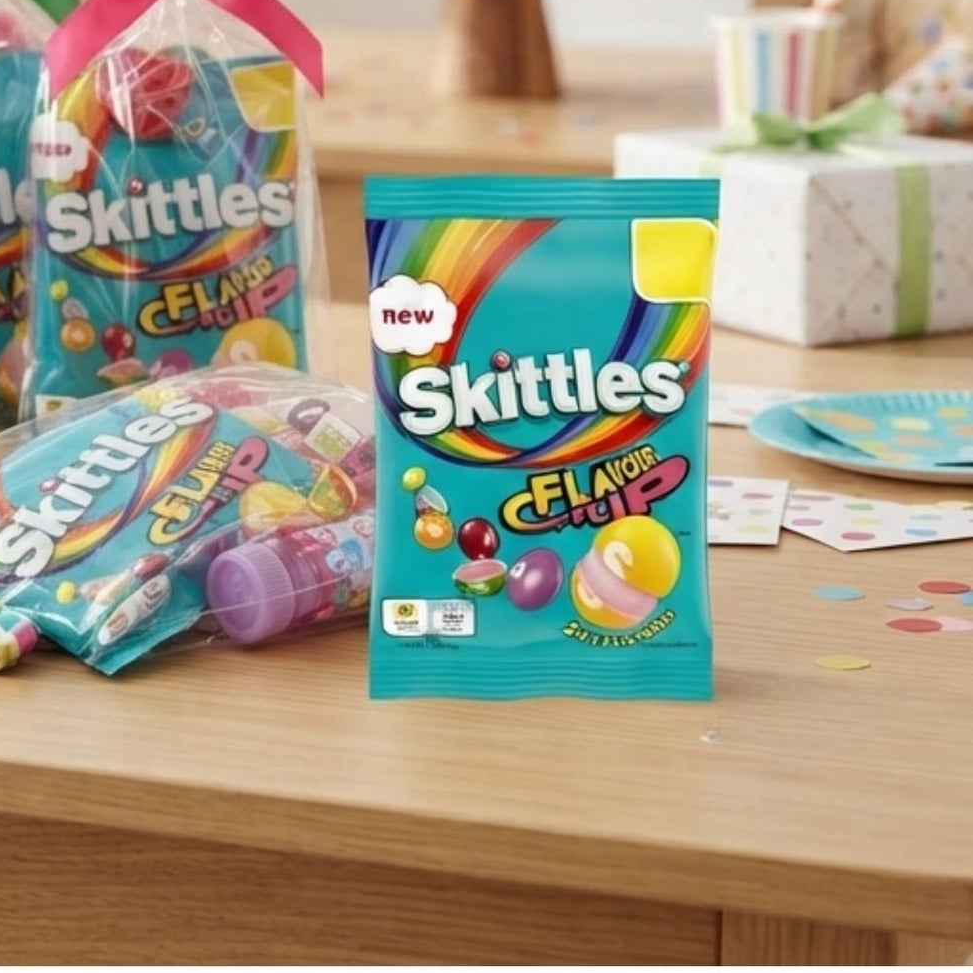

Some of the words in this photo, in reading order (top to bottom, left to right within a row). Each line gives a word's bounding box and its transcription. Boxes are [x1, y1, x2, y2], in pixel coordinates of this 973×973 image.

[46, 173, 294, 253] Skittles
[382, 309, 434, 324] new
[399, 348, 684, 435] Skittles
